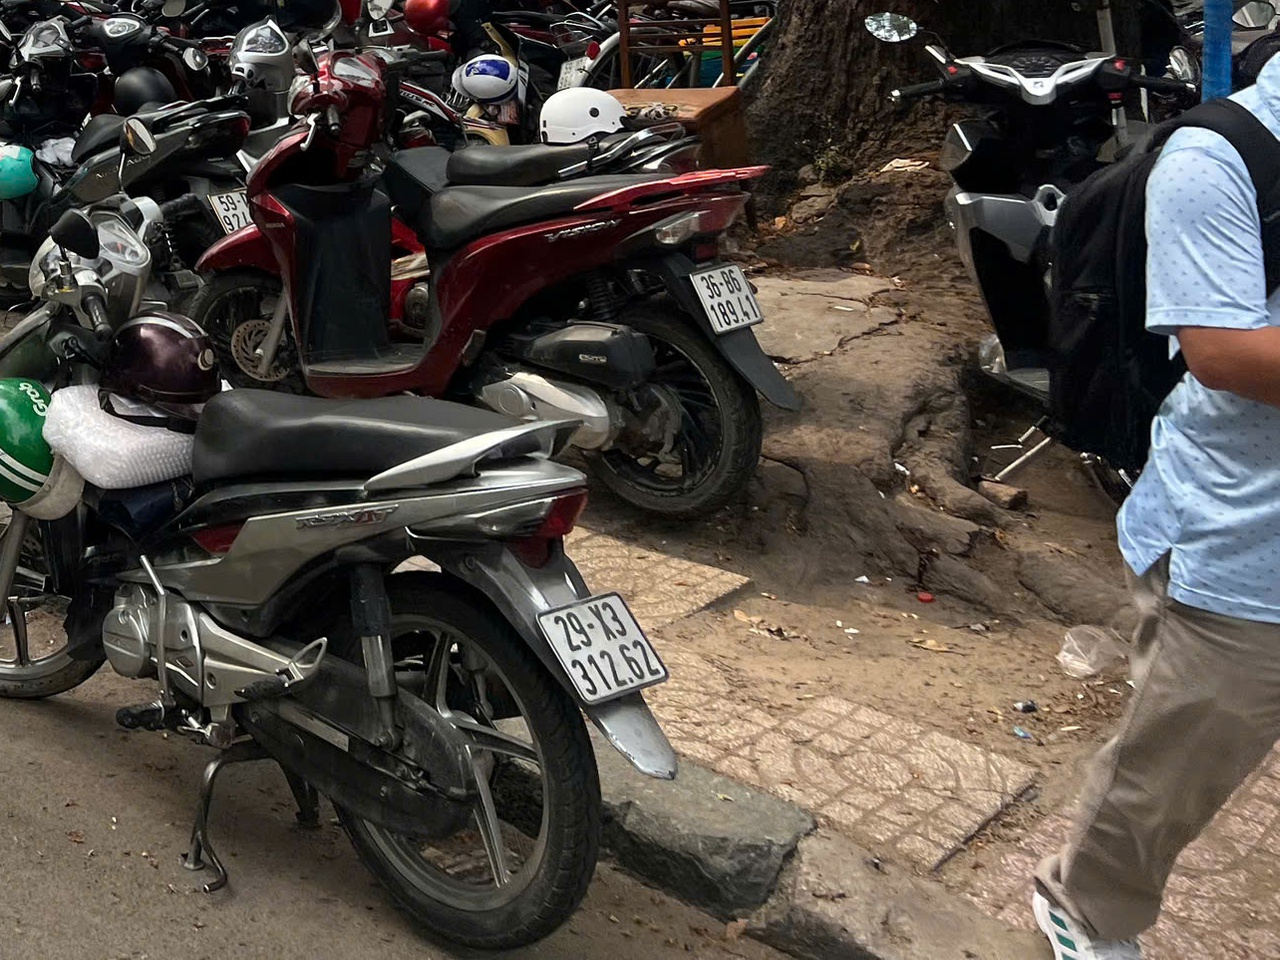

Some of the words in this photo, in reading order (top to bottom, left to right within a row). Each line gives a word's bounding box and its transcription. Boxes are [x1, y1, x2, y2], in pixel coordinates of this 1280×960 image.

[700, 268, 743, 300] 36-B6
[710, 294, 759, 328] 189.41
[553, 601, 628, 652] 29-X3
[571, 639, 661, 696] 312.62
